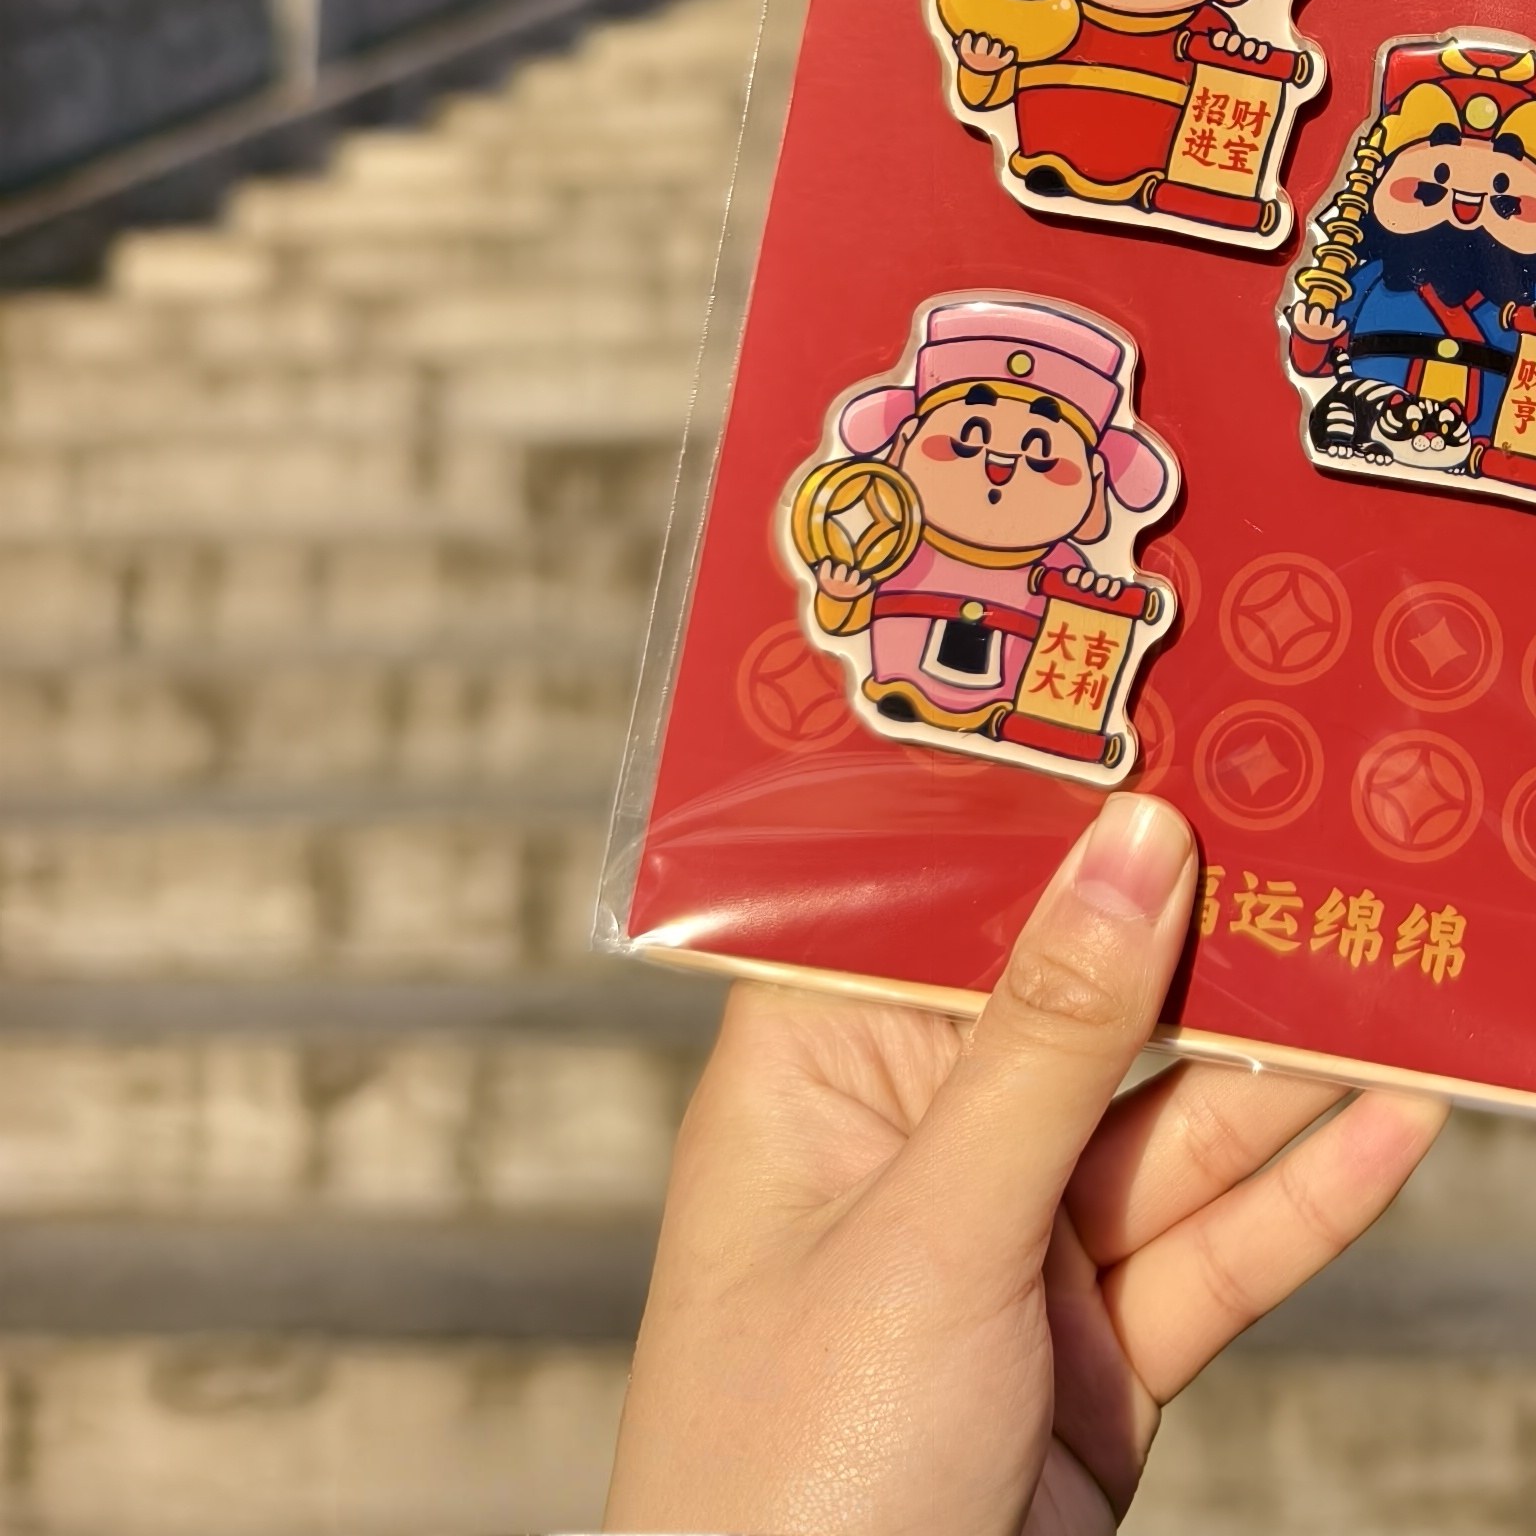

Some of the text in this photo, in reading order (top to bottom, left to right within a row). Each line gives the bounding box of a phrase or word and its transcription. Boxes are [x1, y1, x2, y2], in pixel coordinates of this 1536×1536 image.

[1191, 86, 1272, 138] 招财
[1181, 127, 1259, 175] 进宝
[1040, 621, 1120, 670] 大吉
[1027, 660, 1109, 711] 大利
